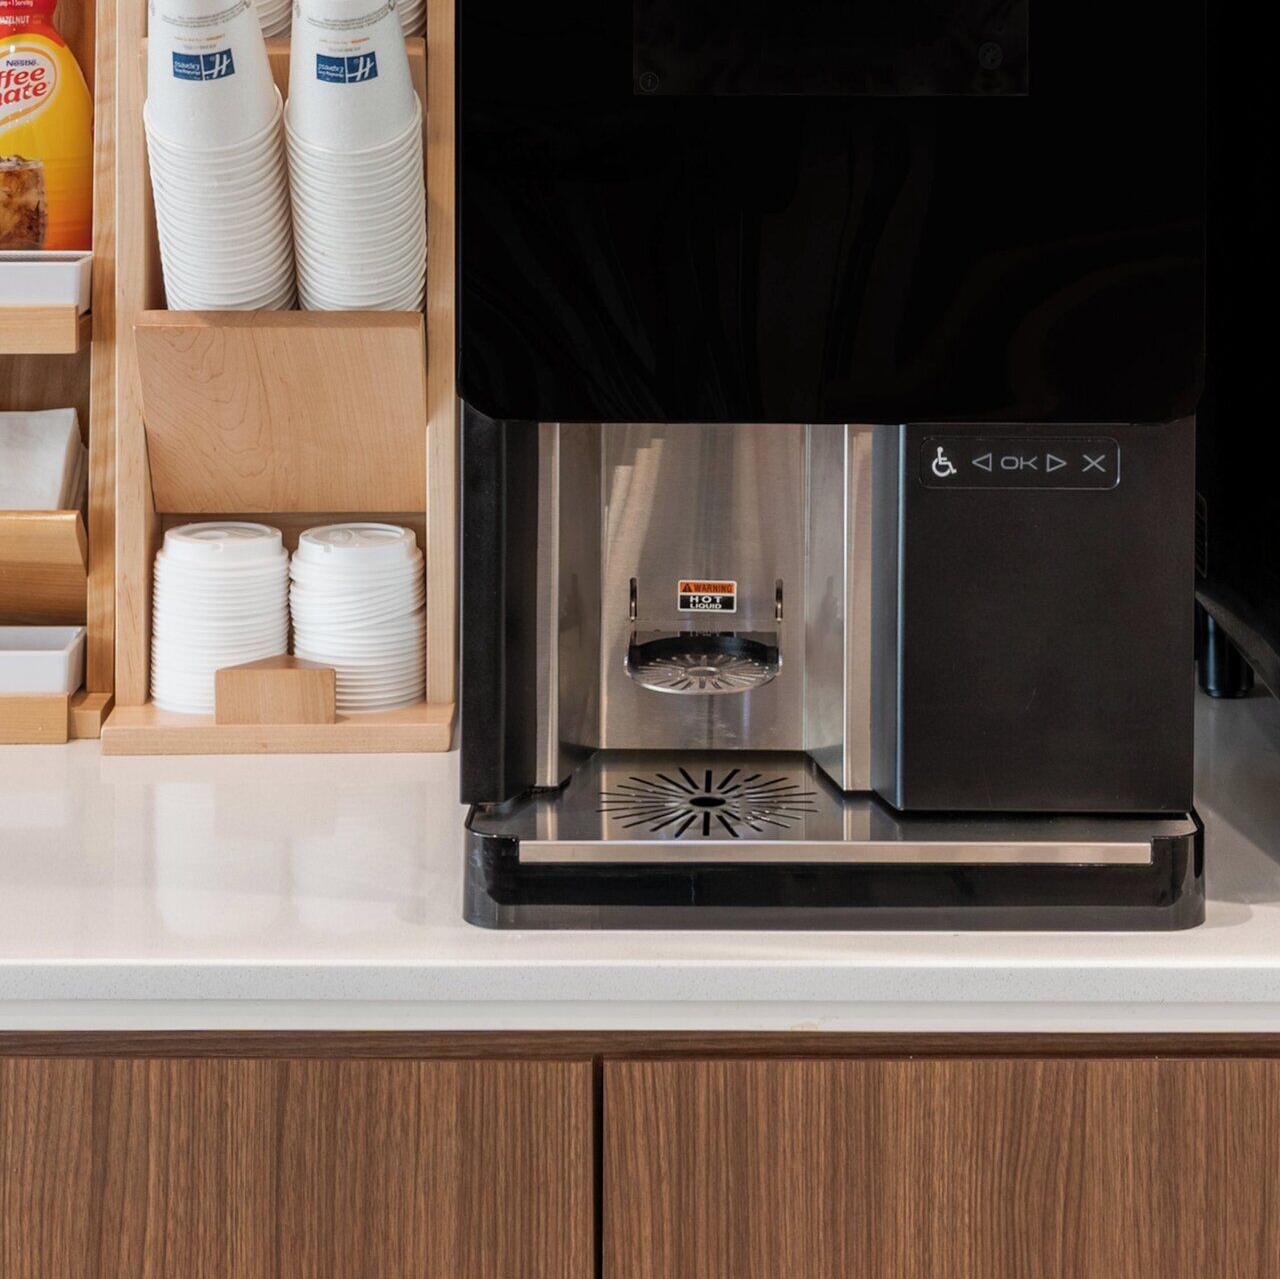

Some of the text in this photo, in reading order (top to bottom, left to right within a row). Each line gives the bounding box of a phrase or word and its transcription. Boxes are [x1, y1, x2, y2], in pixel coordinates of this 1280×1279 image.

[1000, 456, 1038, 470] OK
[693, 583, 733, 593] WARNING
[689, 595, 723, 603] HOT
